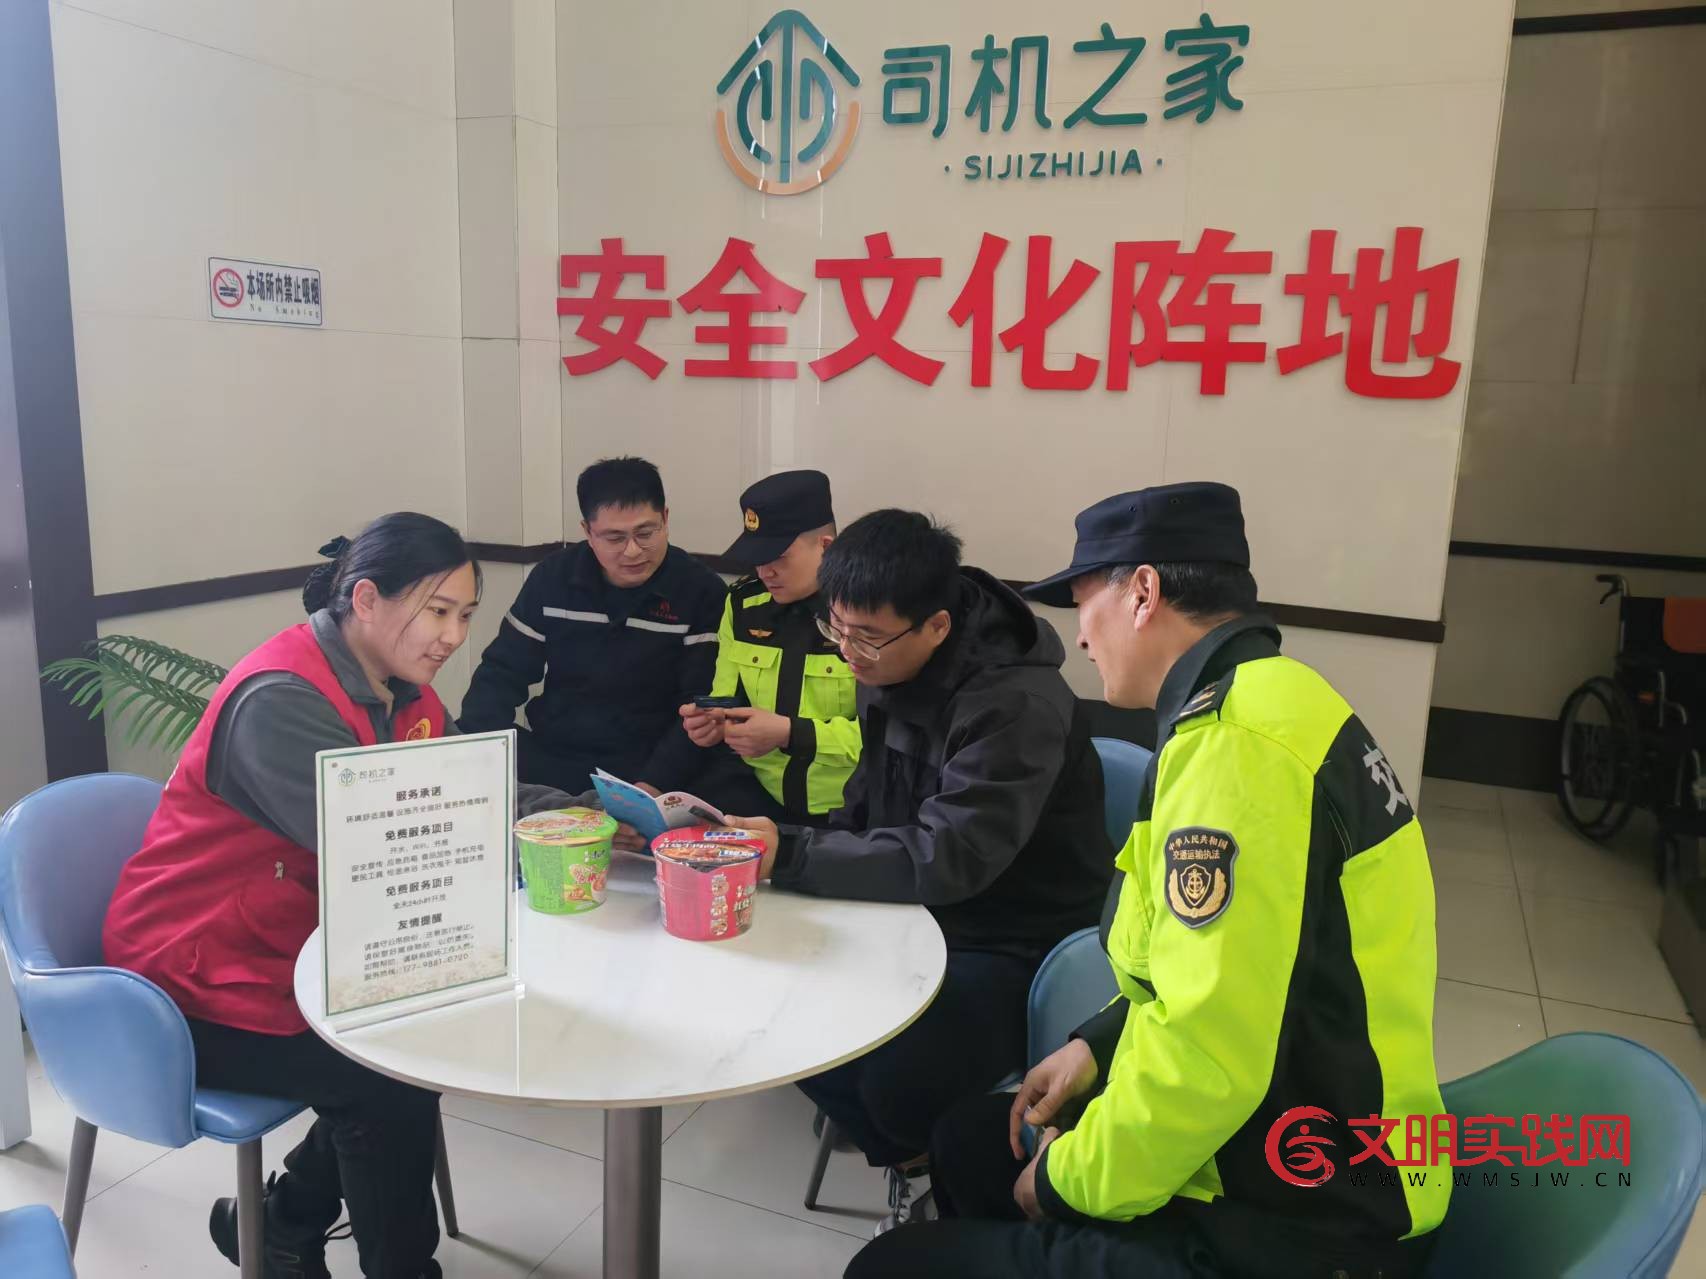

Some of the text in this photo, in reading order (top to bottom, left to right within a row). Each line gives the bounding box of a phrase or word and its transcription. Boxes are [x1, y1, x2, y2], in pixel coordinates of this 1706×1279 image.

[881, 13, 1250, 138] 司机之家
[964, 148, 1142, 180] SIJIZHIJIA
[246, 269, 320, 305] 本场所内禁止吸烟
[557, 227, 1461, 399] 安全文化阵地
[396, 786, 441, 801] 服务承诺
[385, 822, 453, 841] 免费服务项目
[1168, 834, 1229, 851] 中华人民共和国
[1173, 849, 1220, 860] 交通运输执法
[385, 876, 453, 897] 免费服务项目
[398, 913, 442, 930] 友情提醒
